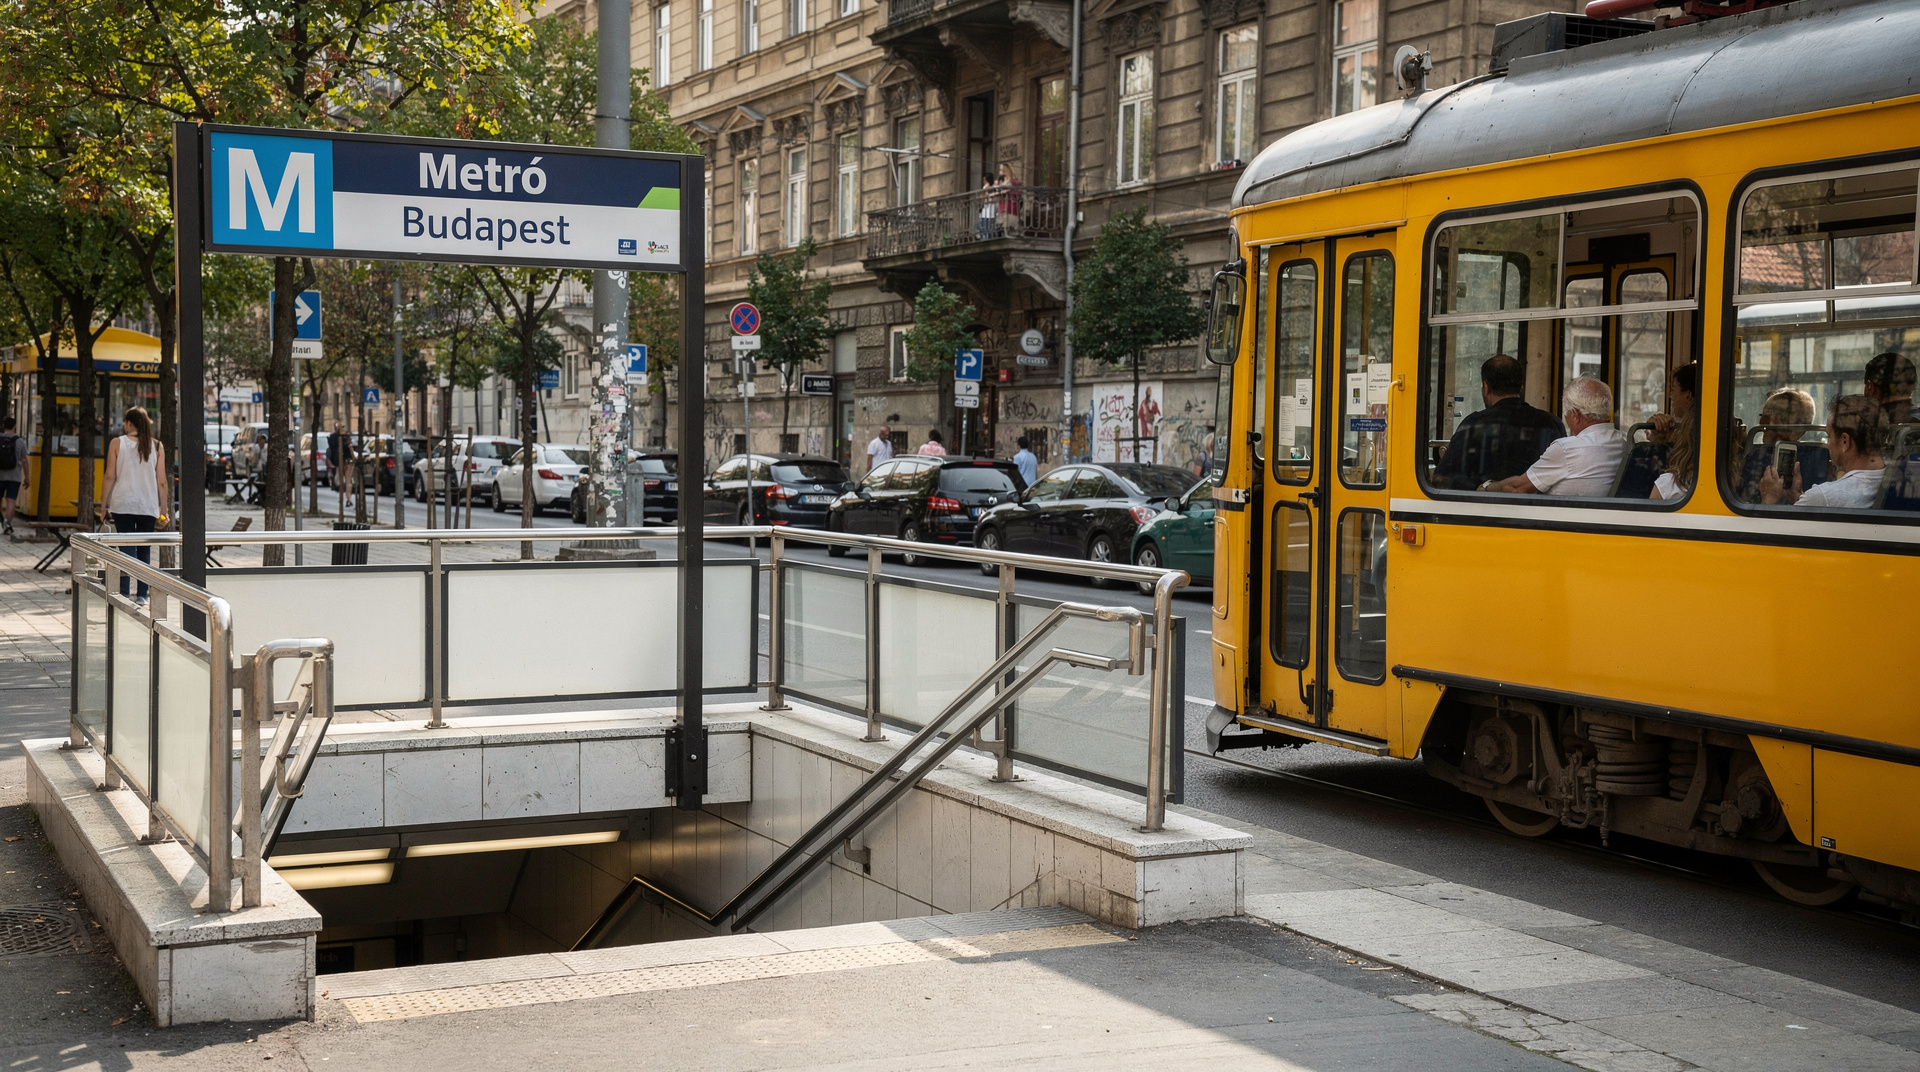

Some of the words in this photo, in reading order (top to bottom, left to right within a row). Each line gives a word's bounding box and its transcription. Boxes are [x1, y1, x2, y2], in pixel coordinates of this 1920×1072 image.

[229, 147, 316, 234] M
[419, 152, 547, 195] Metró
[403, 205, 571, 251] Budapest
[628, 347, 642, 368] P
[961, 352, 977, 376] P
